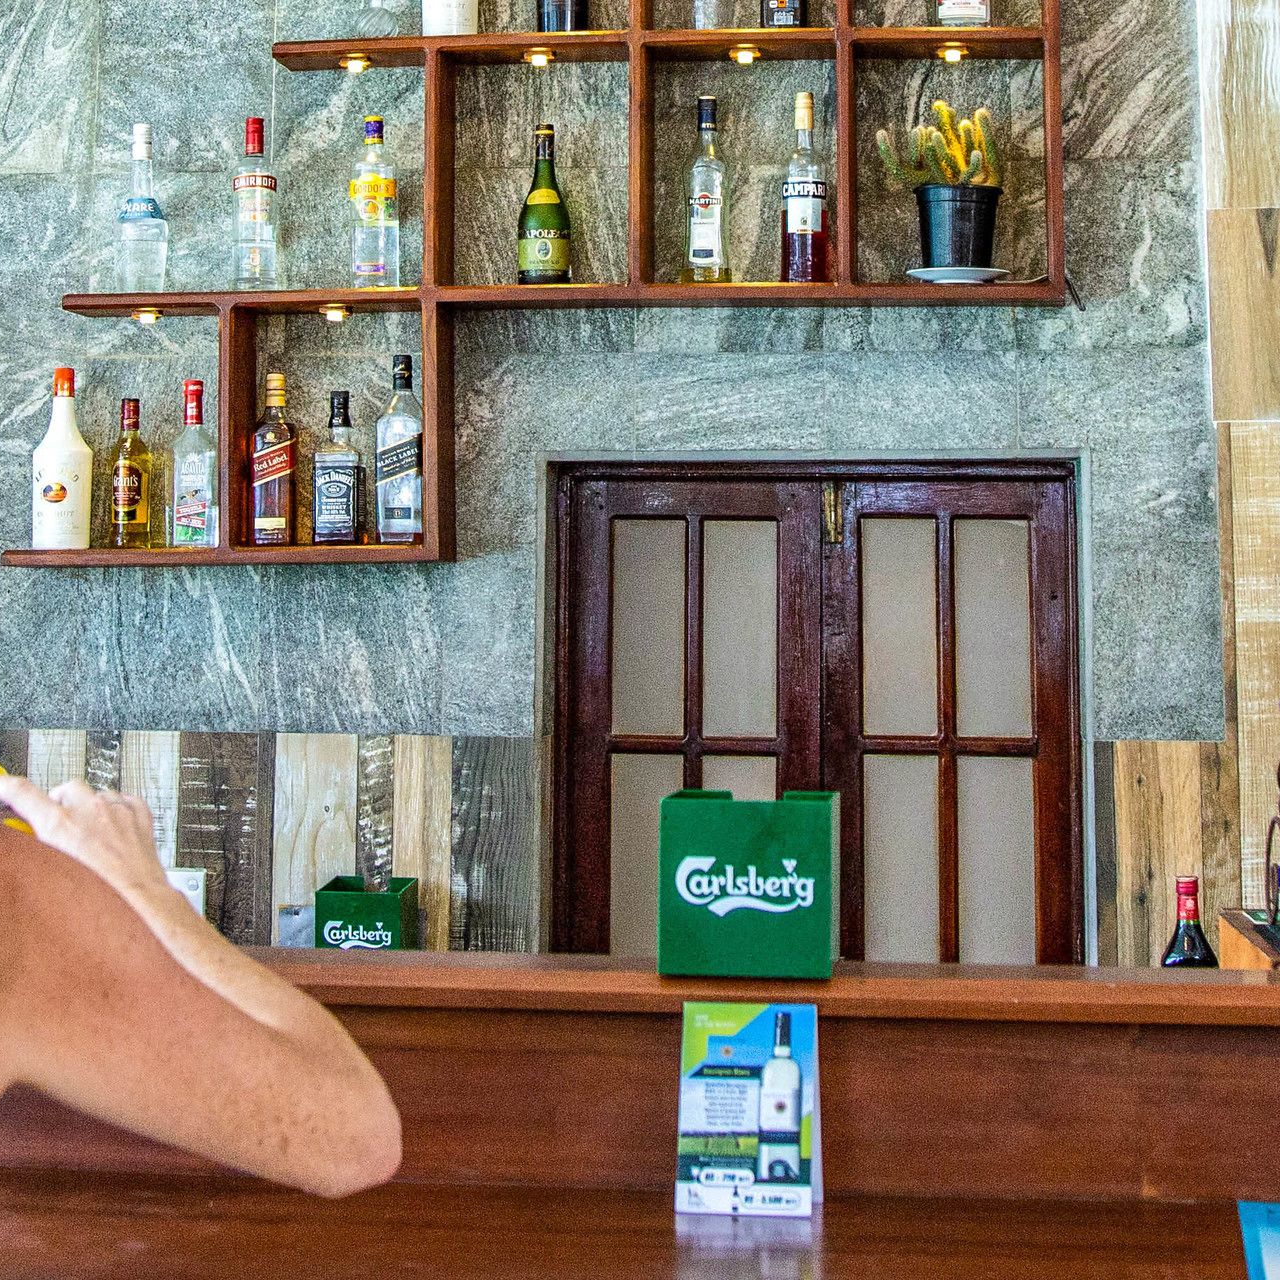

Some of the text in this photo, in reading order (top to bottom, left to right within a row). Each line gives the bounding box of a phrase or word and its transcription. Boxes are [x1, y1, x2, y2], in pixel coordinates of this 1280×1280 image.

[234, 176, 276, 189] SMIRNOFF
[782, 181, 826, 198] CAMPARI
[689, 197, 721, 206] MARTINI
[254, 460, 269, 472] Red
[267, 452, 289, 467] Label
[377, 454, 399, 468] BLACK
[398, 447, 419, 460] LABEL
[316, 473, 330, 488] JACK
[675, 856, 815, 917] Carlsberg
[323, 920, 392, 950] Carlsberg
